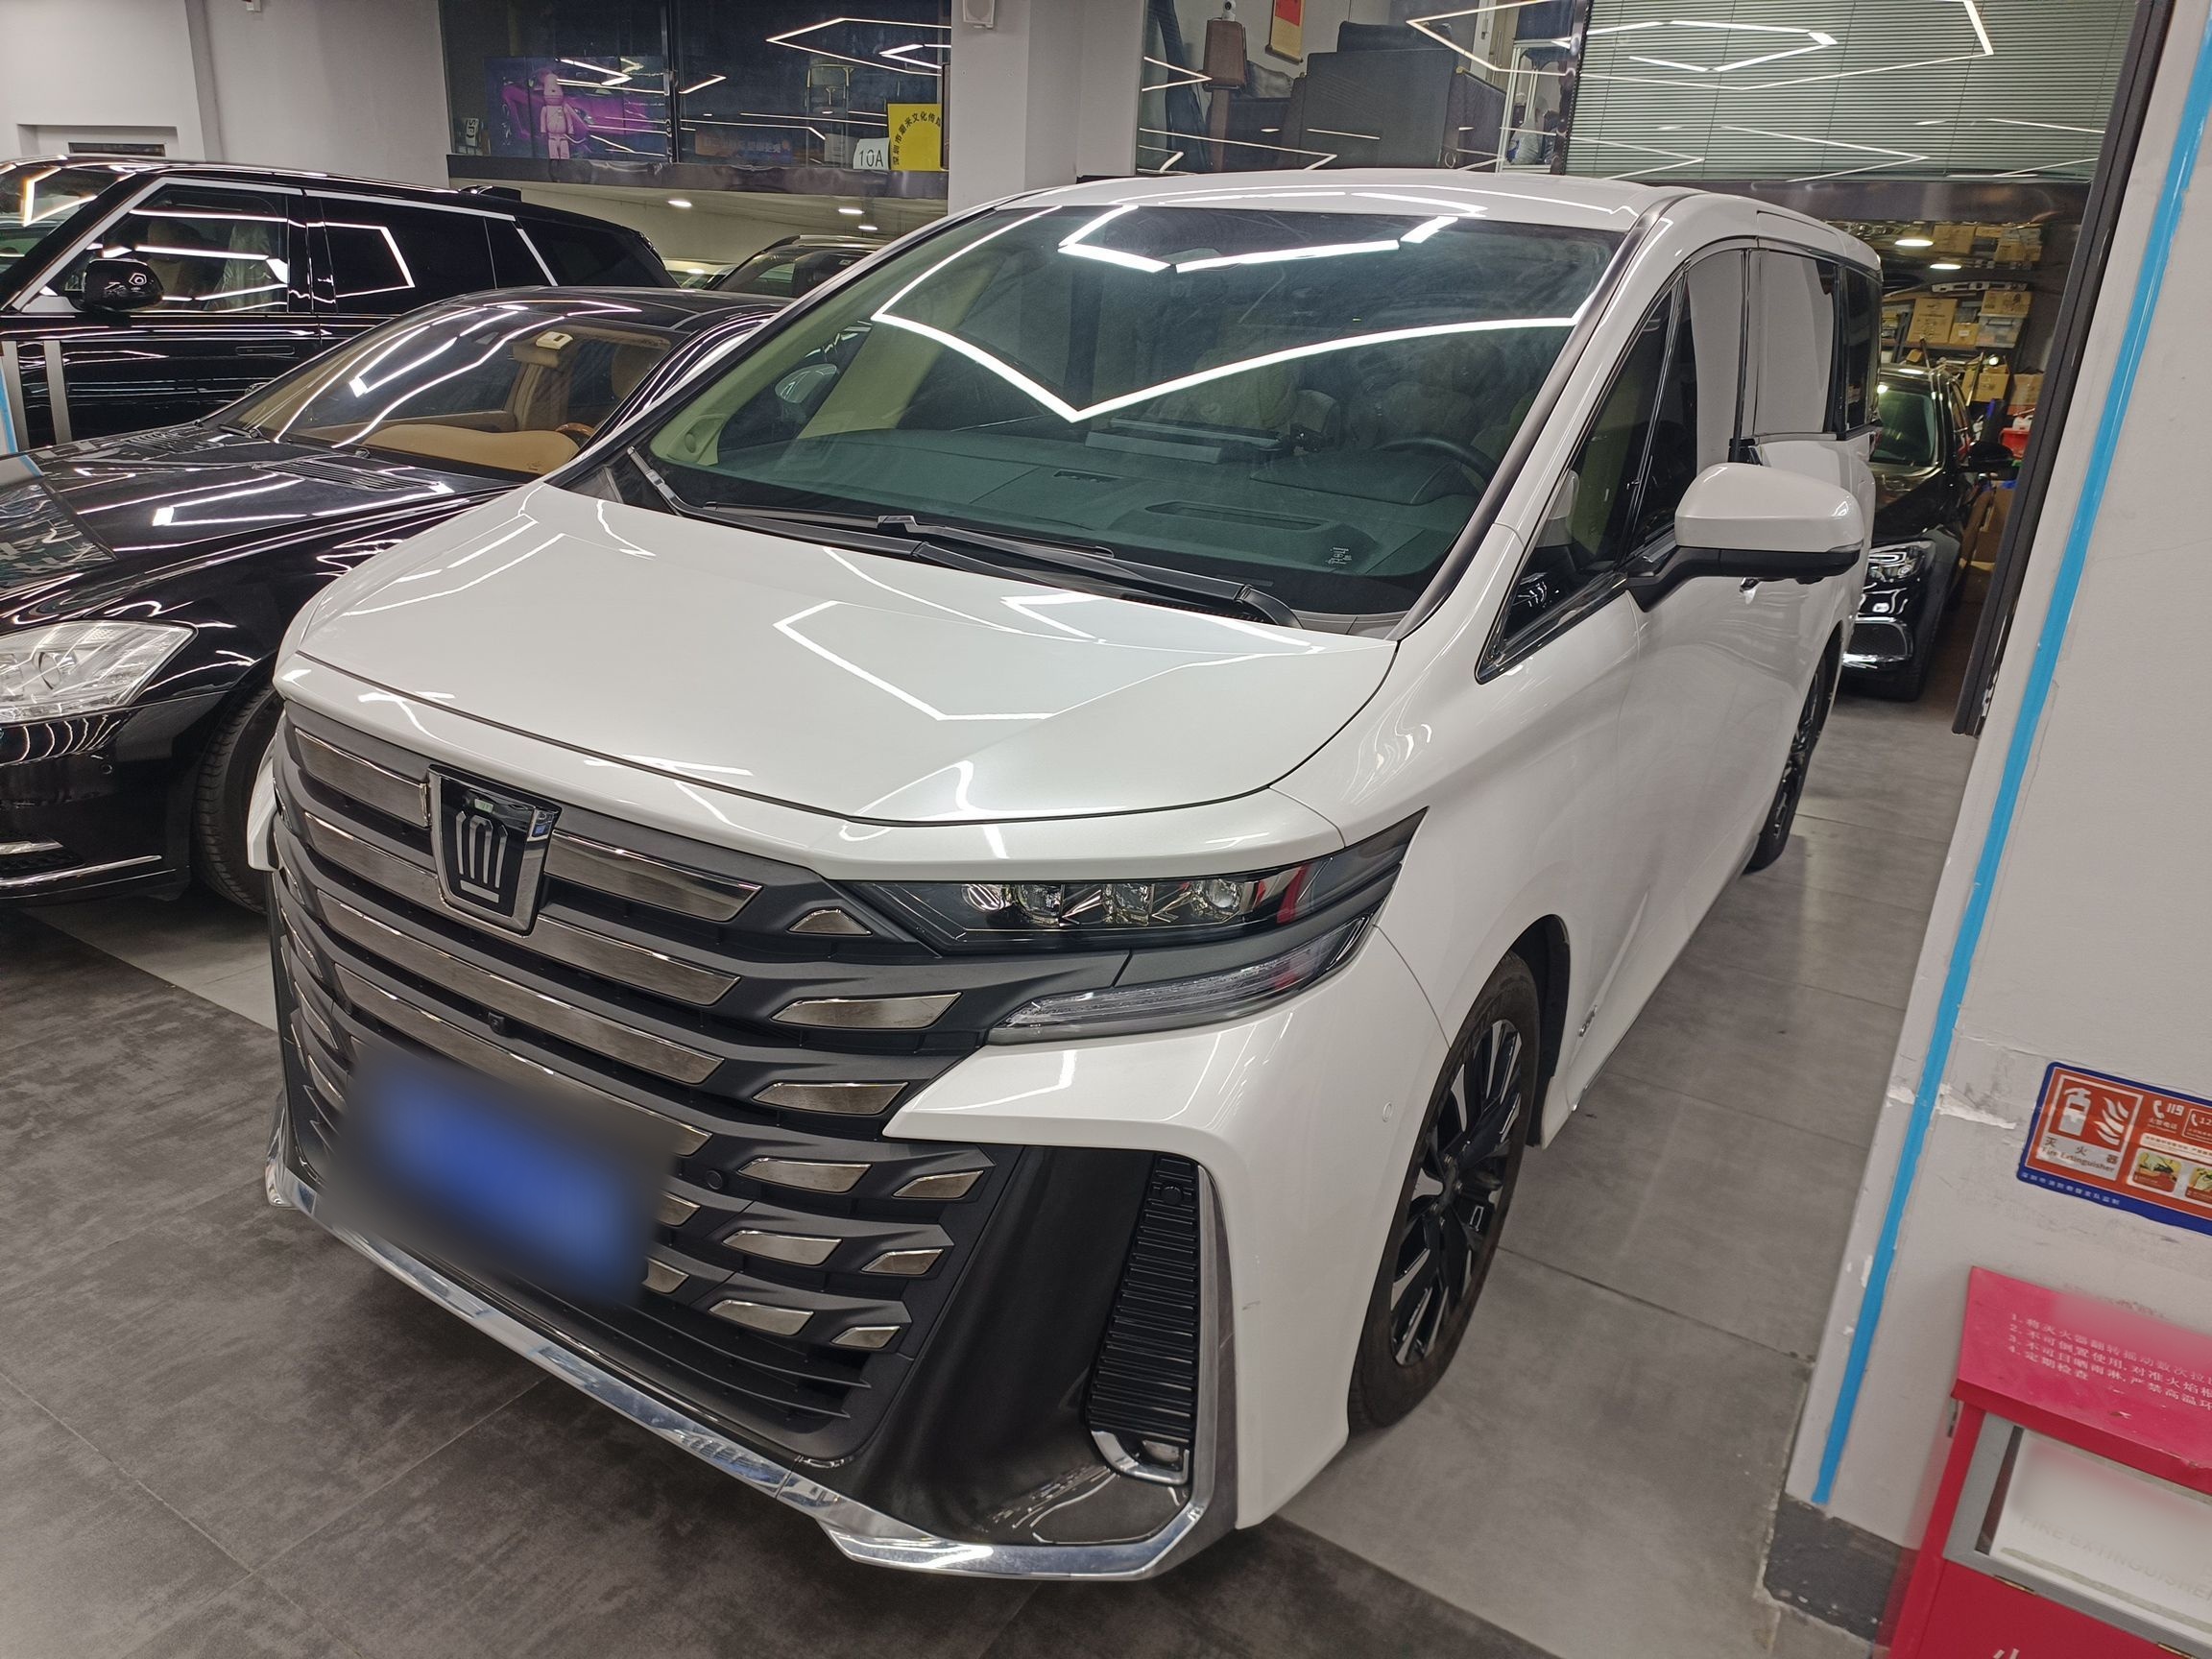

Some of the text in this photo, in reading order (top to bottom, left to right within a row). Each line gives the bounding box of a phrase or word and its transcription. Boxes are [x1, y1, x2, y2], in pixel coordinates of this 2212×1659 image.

[859, 149, 884, 168] 10A
[2166, 1102, 2185, 1117] 119
[2041, 1146, 2115, 1172] Fire Extinguisher
[2020, 1509, 2064, 1541] FIRE
